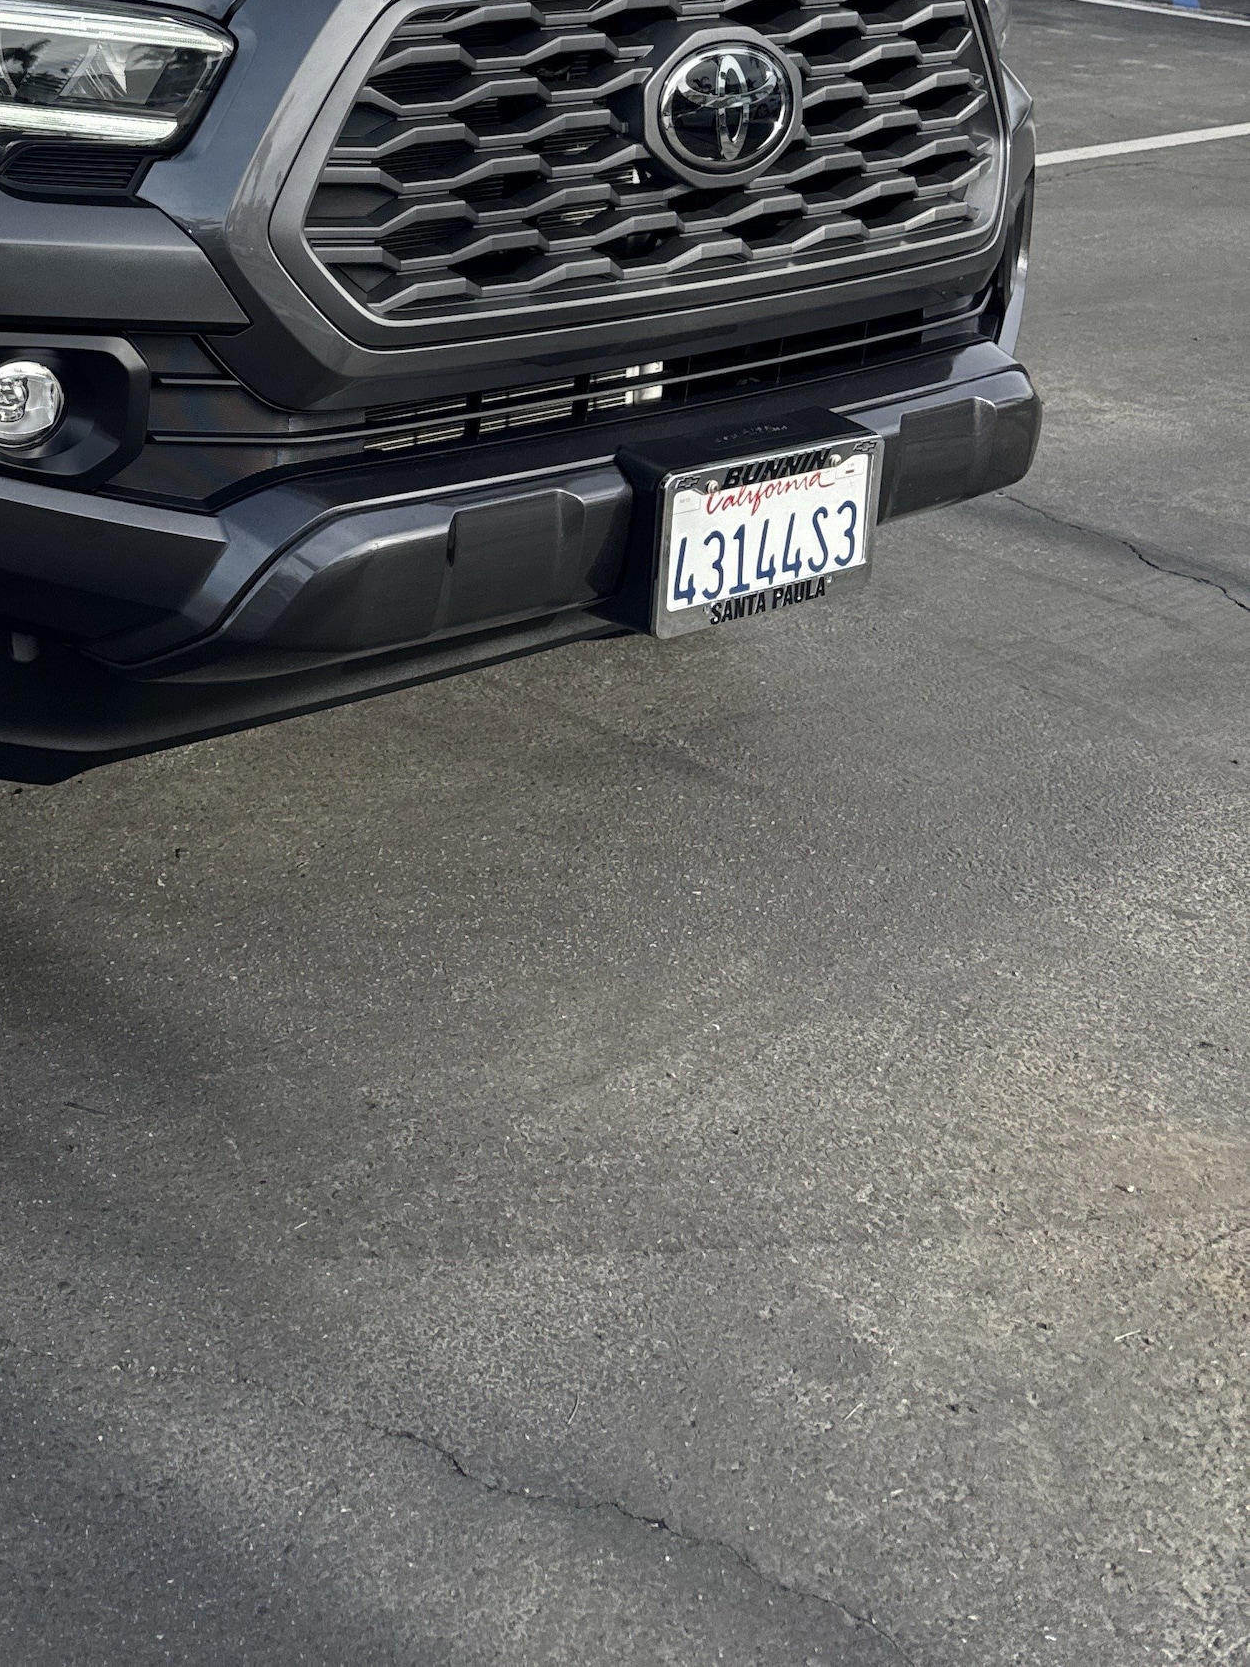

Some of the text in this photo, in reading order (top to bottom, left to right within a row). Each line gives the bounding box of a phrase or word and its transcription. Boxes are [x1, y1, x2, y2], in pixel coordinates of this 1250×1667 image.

[706, 469, 836, 517] California
[725, 448, 832, 489] BUNNIN
[673, 499, 858, 605] 43144S3
[710, 575, 826, 625] SANTA PAULA
